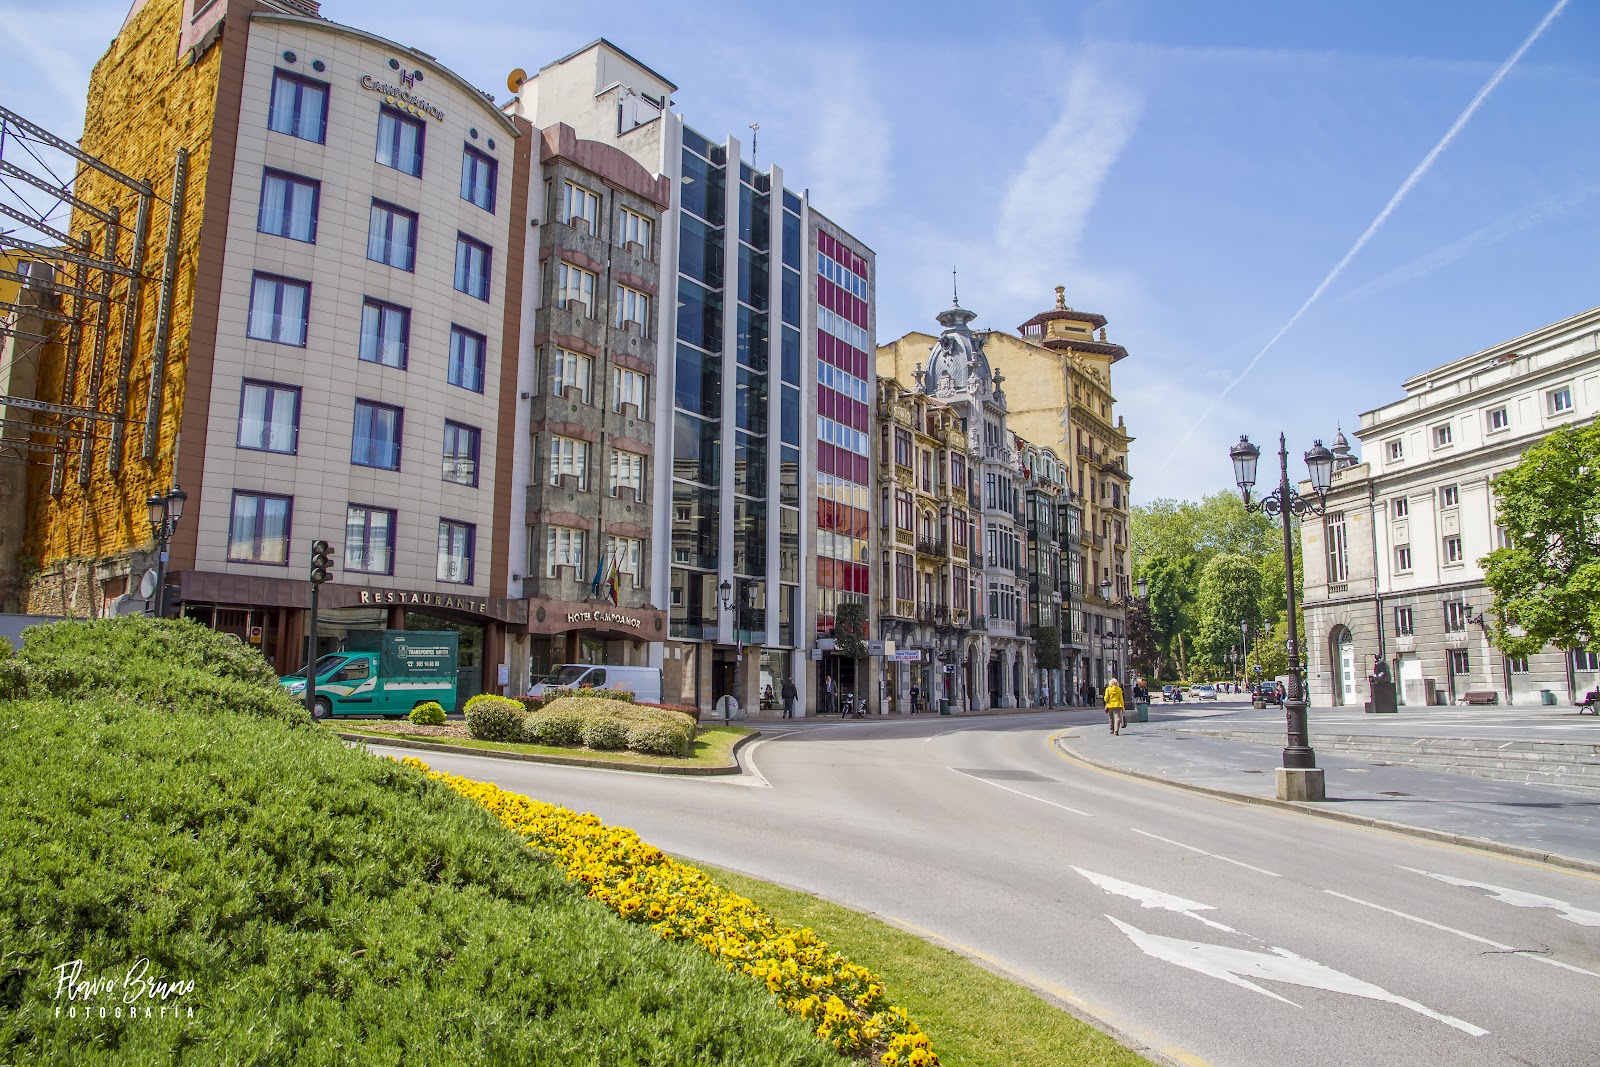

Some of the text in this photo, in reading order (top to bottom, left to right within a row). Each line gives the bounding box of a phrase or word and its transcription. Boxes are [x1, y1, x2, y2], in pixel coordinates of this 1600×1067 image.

[402, 69, 415, 88] H
[361, 75, 445, 121] CAMPOAMOR
[360, 591, 486, 612] RESTAURANTE
[567, 611, 641, 628] HOTEL CAMPOAMOR
